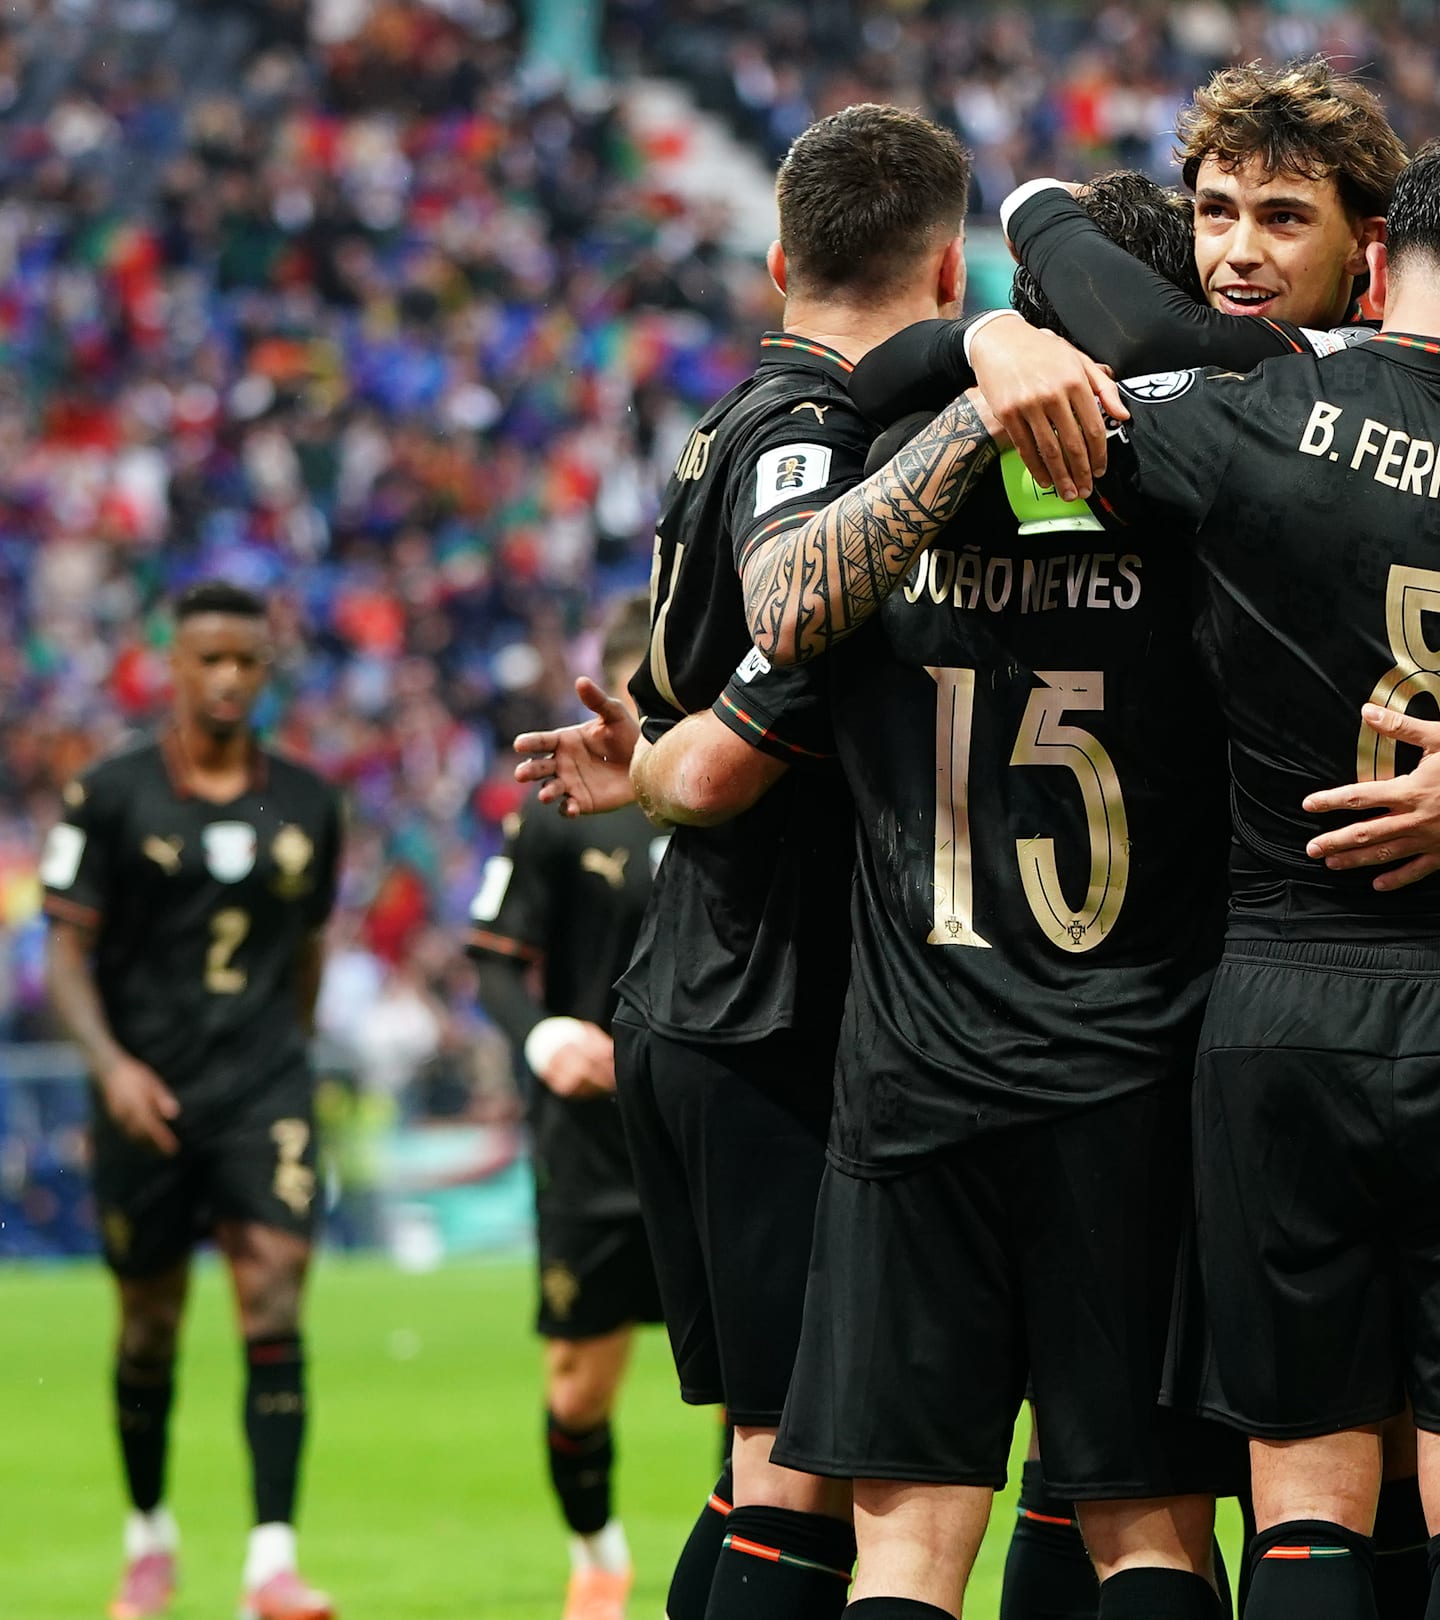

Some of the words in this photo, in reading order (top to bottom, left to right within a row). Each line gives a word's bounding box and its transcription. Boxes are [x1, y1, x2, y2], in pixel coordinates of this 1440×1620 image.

[1298, 400, 1343, 463] B.
[903, 543, 1013, 613] JOÃO
[1020, 553, 1143, 615] NEVES
[922, 665, 1131, 953] 15
[205, 906, 249, 995] 2
